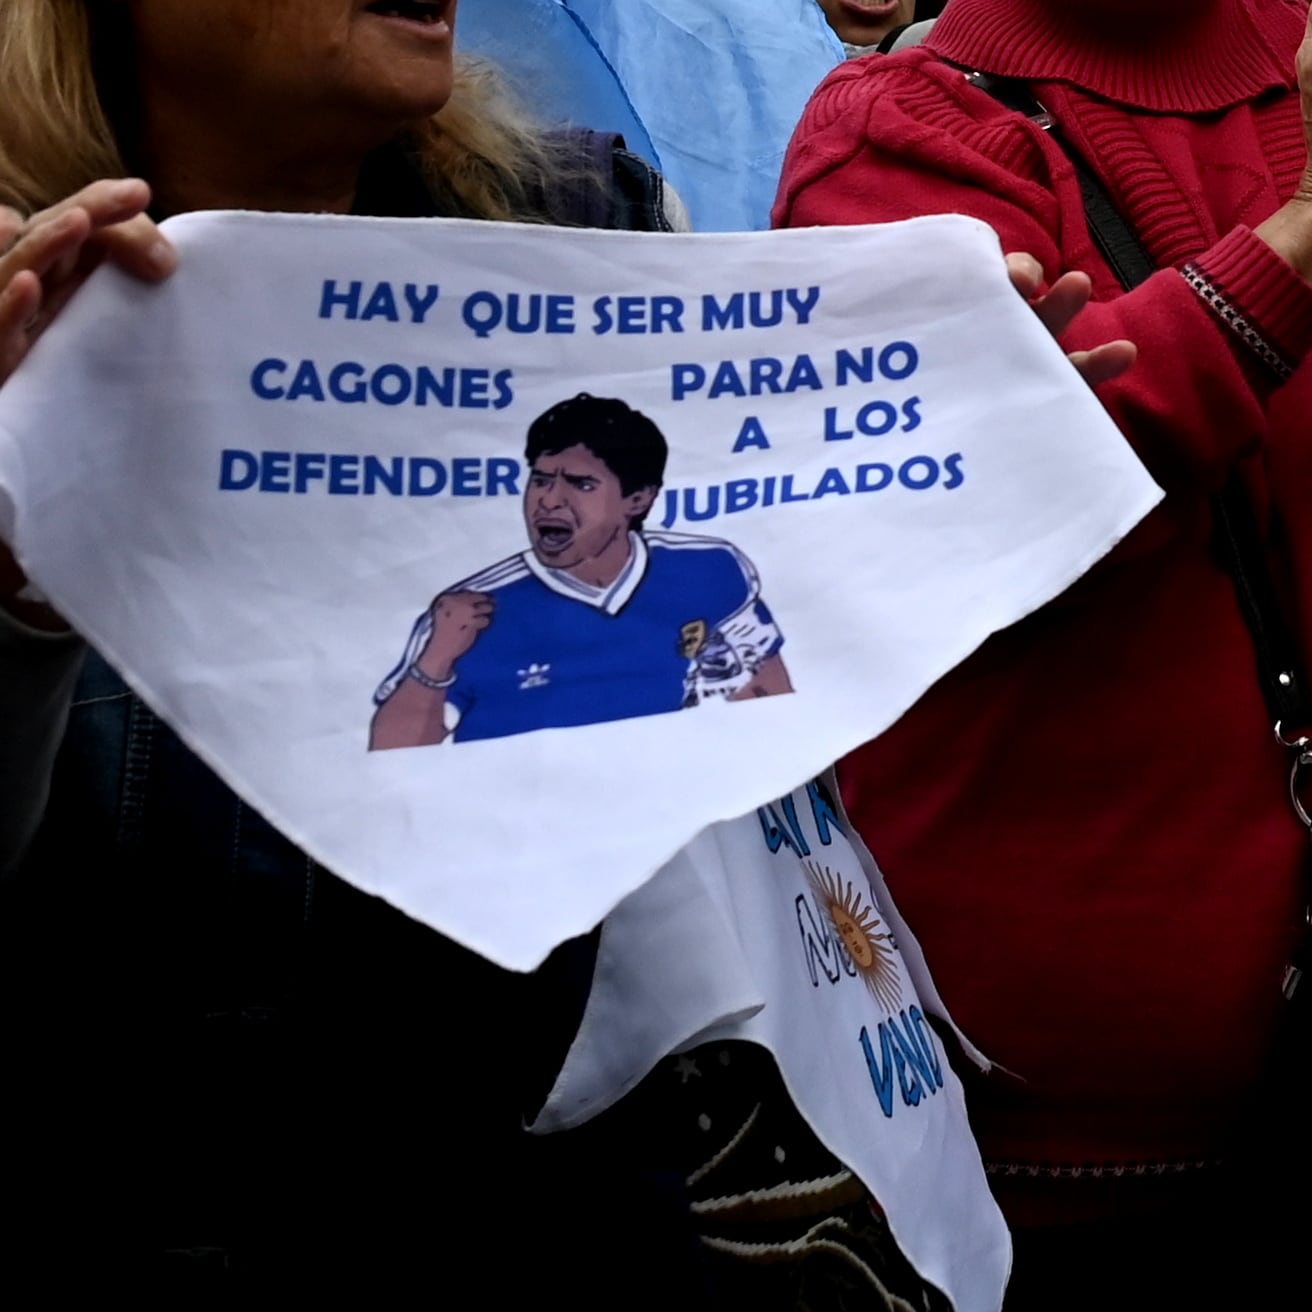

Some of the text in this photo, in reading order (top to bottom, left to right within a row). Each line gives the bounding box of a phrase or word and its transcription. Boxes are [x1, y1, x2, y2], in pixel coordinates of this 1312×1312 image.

[318, 279, 820, 338] HAY QUE SER MUY
[250, 341, 919, 409] CAGONES PARA NO
[733, 396, 922, 452] A LOS
[218, 449, 520, 497] DEFENDER
[660, 452, 964, 528] JUBILADOS
